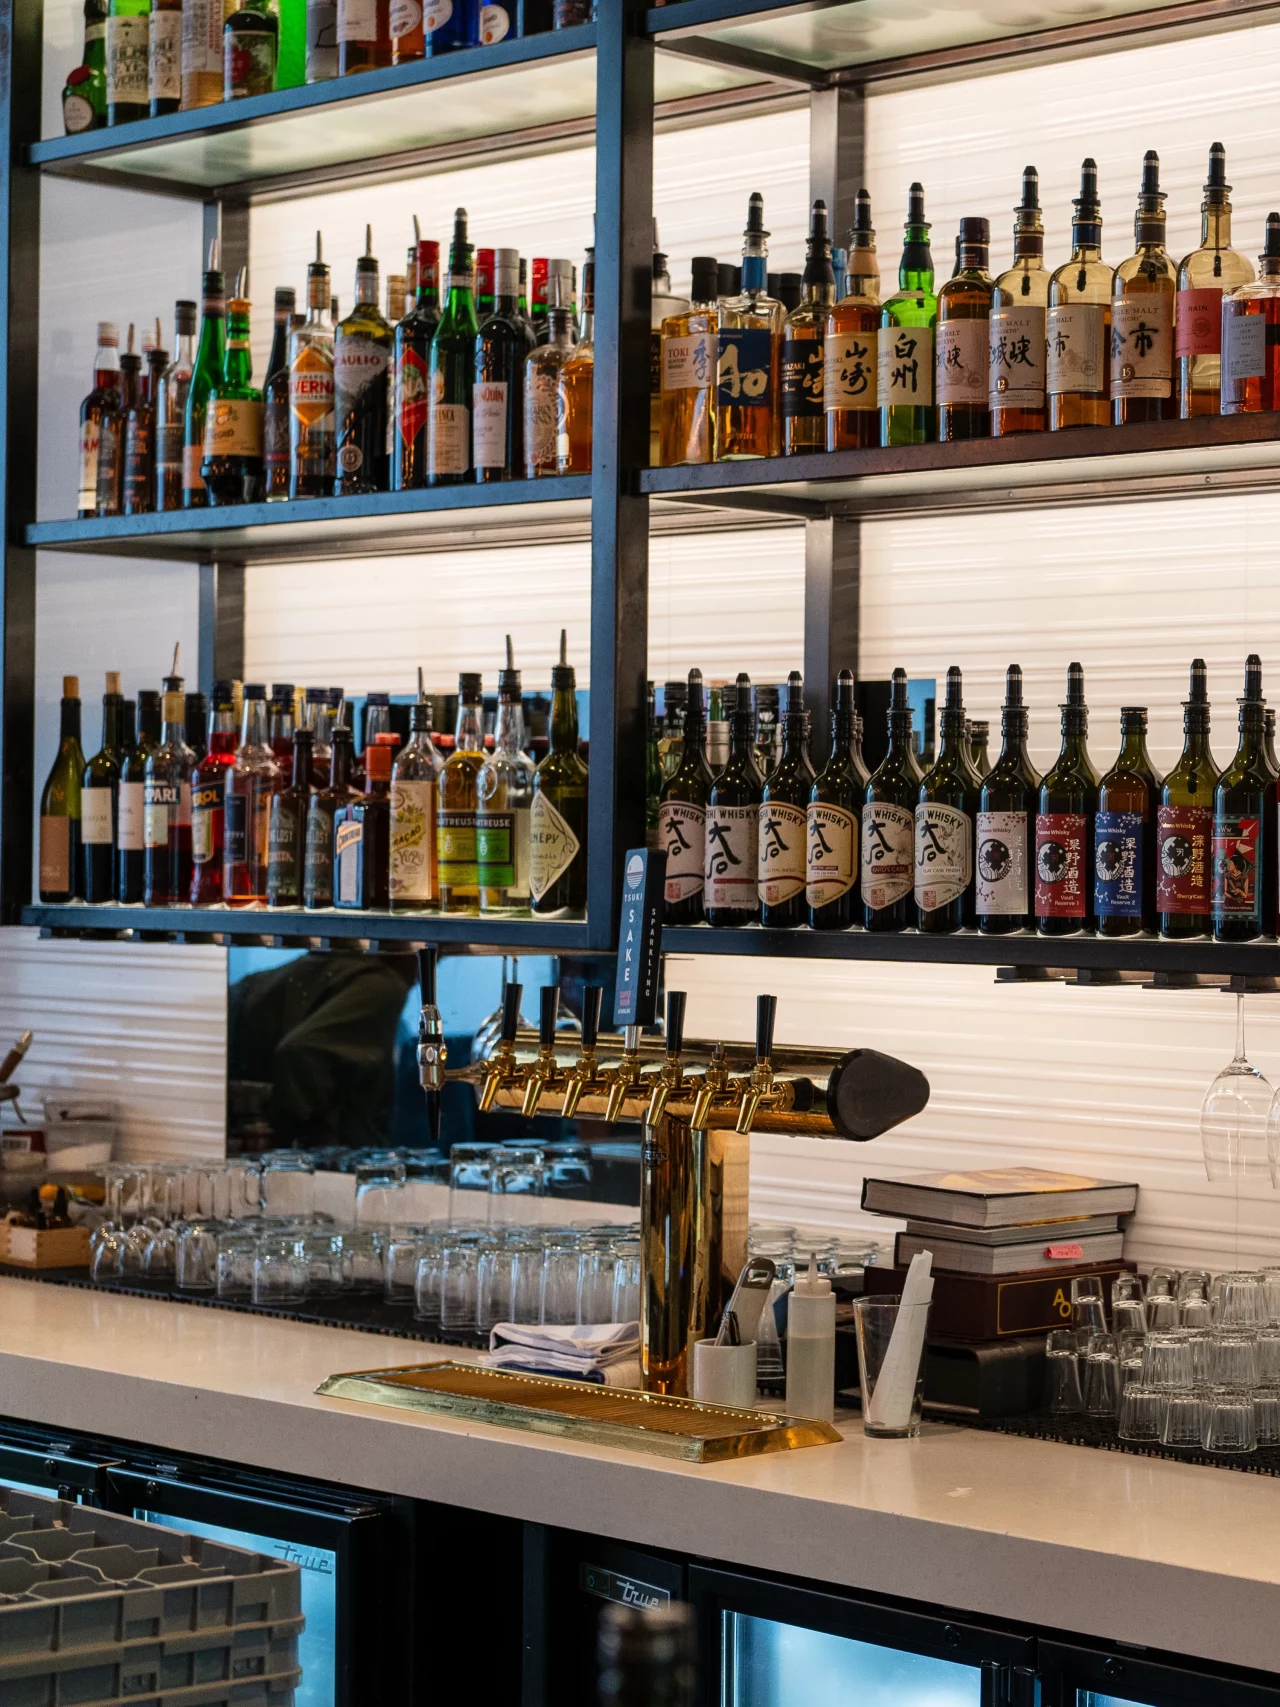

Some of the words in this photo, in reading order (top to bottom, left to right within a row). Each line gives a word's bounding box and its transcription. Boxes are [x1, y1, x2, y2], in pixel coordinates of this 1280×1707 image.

[335, 356, 380, 367] AULIO
[668, 348, 689, 358] TOKI
[841, 341, 872, 395] 山崎
[891, 332, 918, 393] 白州
[989, 335, 1035, 369] 城峡
[997, 380, 1005, 389] 12
[1122, 368, 1131, 377] 15
[720, 809, 757, 819] WHISKY
[770, 808, 806, 827] WHISKY
[815, 809, 850, 829] WHISKY
[874, 809, 911, 828] WHISKY
[927, 810, 964, 829] WHISKY
[1051, 829, 1070, 837] Whisky
[706, 821, 741, 880] 大石
[761, 818, 790, 863] 大石
[808, 820, 833, 864] 大石
[865, 820, 896, 865] 大石
[918, 820, 946, 866] 大石
[1063, 839, 1081, 894] 深野酒造
[1119, 837, 1136, 893] 深野酒造
[1190, 835, 1205, 887] 深野酒造
[625, 893, 643, 901] TSUKI
[624, 909, 635, 981] SAKE
[645, 908, 656, 996] SPARKLING
